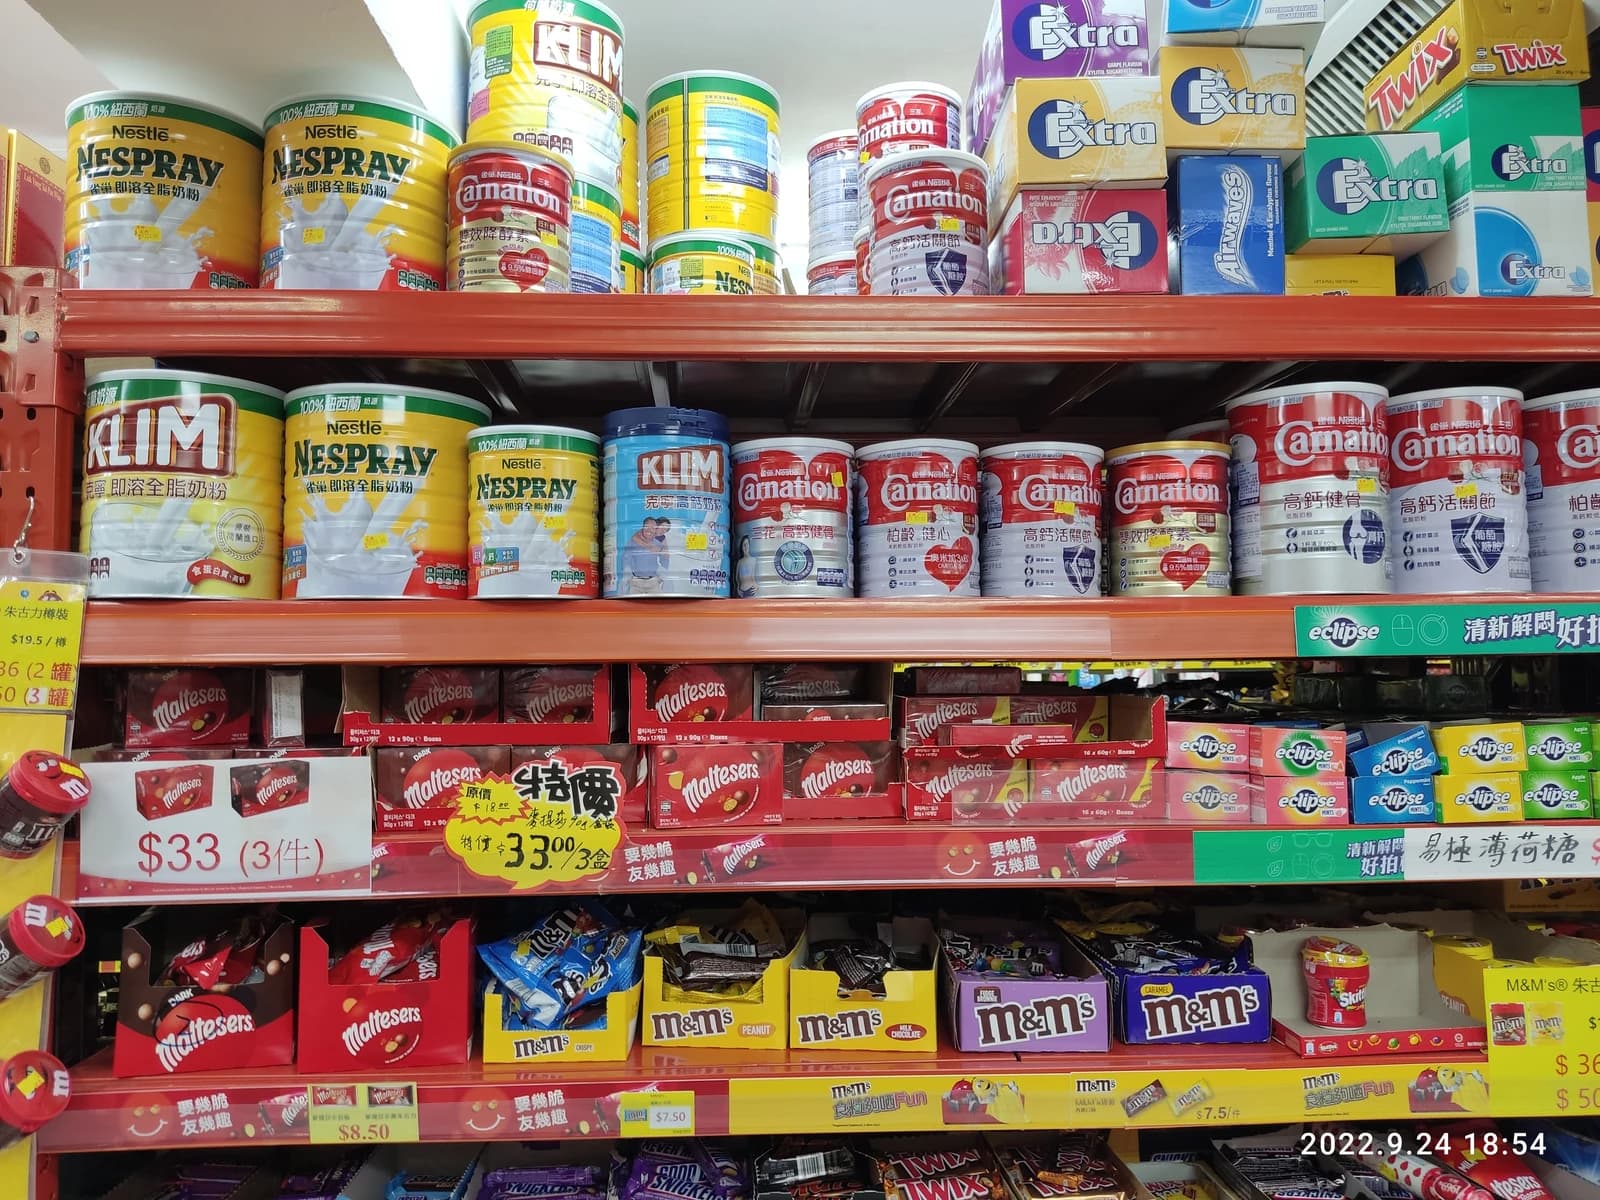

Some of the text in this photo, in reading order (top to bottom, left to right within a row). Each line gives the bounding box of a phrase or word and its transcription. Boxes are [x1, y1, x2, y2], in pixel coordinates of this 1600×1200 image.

[1028, 15, 1139, 50] Extra
[536, 23, 623, 97] KLIM
[1494, 40, 1567, 73] Twix
[1369, 27, 1453, 130] Twix
[83, 103, 110, 120] 100%
[279, 102, 338, 125] 100% 紐西蘭
[1187, 79, 1297, 117] Extra
[1045, 112, 1157, 149] Extra
[76, 143, 224, 188] NESPRAY
[271, 146, 411, 185] NESPRAY
[1501, 153, 1567, 174] Extra
[114, 181, 200, 202] 即溶全脂奶粉
[307, 181, 388, 199] 即溶全脂奶粉
[456, 174, 563, 213] Carnation
[1332, 169, 1439, 204] Extra
[884, 184, 984, 225] Carnation
[1031, 221, 1142, 258] Extra
[1214, 169, 1249, 286] Airwaves
[1509, 260, 1566, 280] Extra
[300, 396, 362, 416] 100% 紐西蘭
[87, 403, 223, 470] KLIM
[478, 438, 498, 453] 100%
[1391, 427, 1521, 472] Carnation
[293, 439, 439, 479] NESPRAY
[641, 449, 721, 489] KLIM
[111, 477, 228, 501] 即溶全脂奶粉
[329, 479, 414, 495] 即溶全脂奶粉
[476, 472, 577, 501] NESPRAY
[737, 473, 840, 511] Carnation
[881, 473, 977, 512] Carnation
[1115, 475, 1220, 514] Carnation
[1283, 490, 1361, 511] 高鈣健骨
[1399, 492, 1496, 516] 高鈣活關節
[11, 633, 43, 646] $19.5
[1308, 621, 1380, 645] eclipse
[1463, 610, 1556, 644] 清新解悶
[153, 687, 227, 732] Maltesers
[404, 683, 473, 724] Maltesers
[526, 682, 595, 720] Maltesers
[655, 681, 727, 723] Maltesers
[914, 700, 978, 740] Maltesers
[1179, 738, 1237, 758] eclipse
[1275, 742, 1333, 766] eclipse
[1372, 748, 1423, 776] eclipse
[1459, 739, 1513, 761] eclipse
[1527, 737, 1582, 760] eclipse
[163, 777, 202, 809] Maltesers
[257, 774, 297, 806] Maltesers
[404, 766, 482, 809] Maltesers
[465, 786, 493, 801] 原價
[513, 761, 620, 818] 特價
[681, 761, 760, 813] Maltesers
[801, 759, 873, 799] Maltesers
[925, 762, 994, 804] Maltesers
[1056, 763, 1126, 803] Maltesers
[1182, 788, 1238, 809] eclipse
[1278, 791, 1336, 814] eclipse
[1368, 788, 1424, 812] eclipse
[1455, 788, 1510, 811] eclipse
[1523, 786, 1579, 808] eclipse
[138, 831, 324, 878] $33 (3件)
[624, 840, 674, 864] 要幾脆
[723, 837, 766, 875] Maltesers
[988, 835, 1038, 858] 要幾脆
[1085, 833, 1127, 870] Maltesers
[1418, 831, 1579, 868] 易極薄荷糖
[627, 860, 677, 883] 友幾趣
[992, 854, 1041, 877] 友幾趣
[168, 988, 194, 1007] DARK
[1145, 985, 1170, 995] CARAMEL
[652, 1008, 733, 1041] m&m's
[797, 1008, 883, 1043] m&m's
[976, 994, 1096, 1046] m&m's
[1142, 985, 1260, 1039] m&m's
[156, 1012, 254, 1072] Maltesers
[342, 1006, 422, 1056] Maltesers
[742, 1024, 770, 1036] PEANUT
[891, 1031, 922, 1039] CHOCOLATE
[176, 1092, 229, 1118] 要幾脆
[513, 1088, 565, 1114] 要幾脆
[655, 1111, 687, 1123] $7.50
[180, 1111, 233, 1137] 友幾趣
[338, 1123, 390, 1142] $8.50
[517, 1108, 569, 1132] 友幾趣
